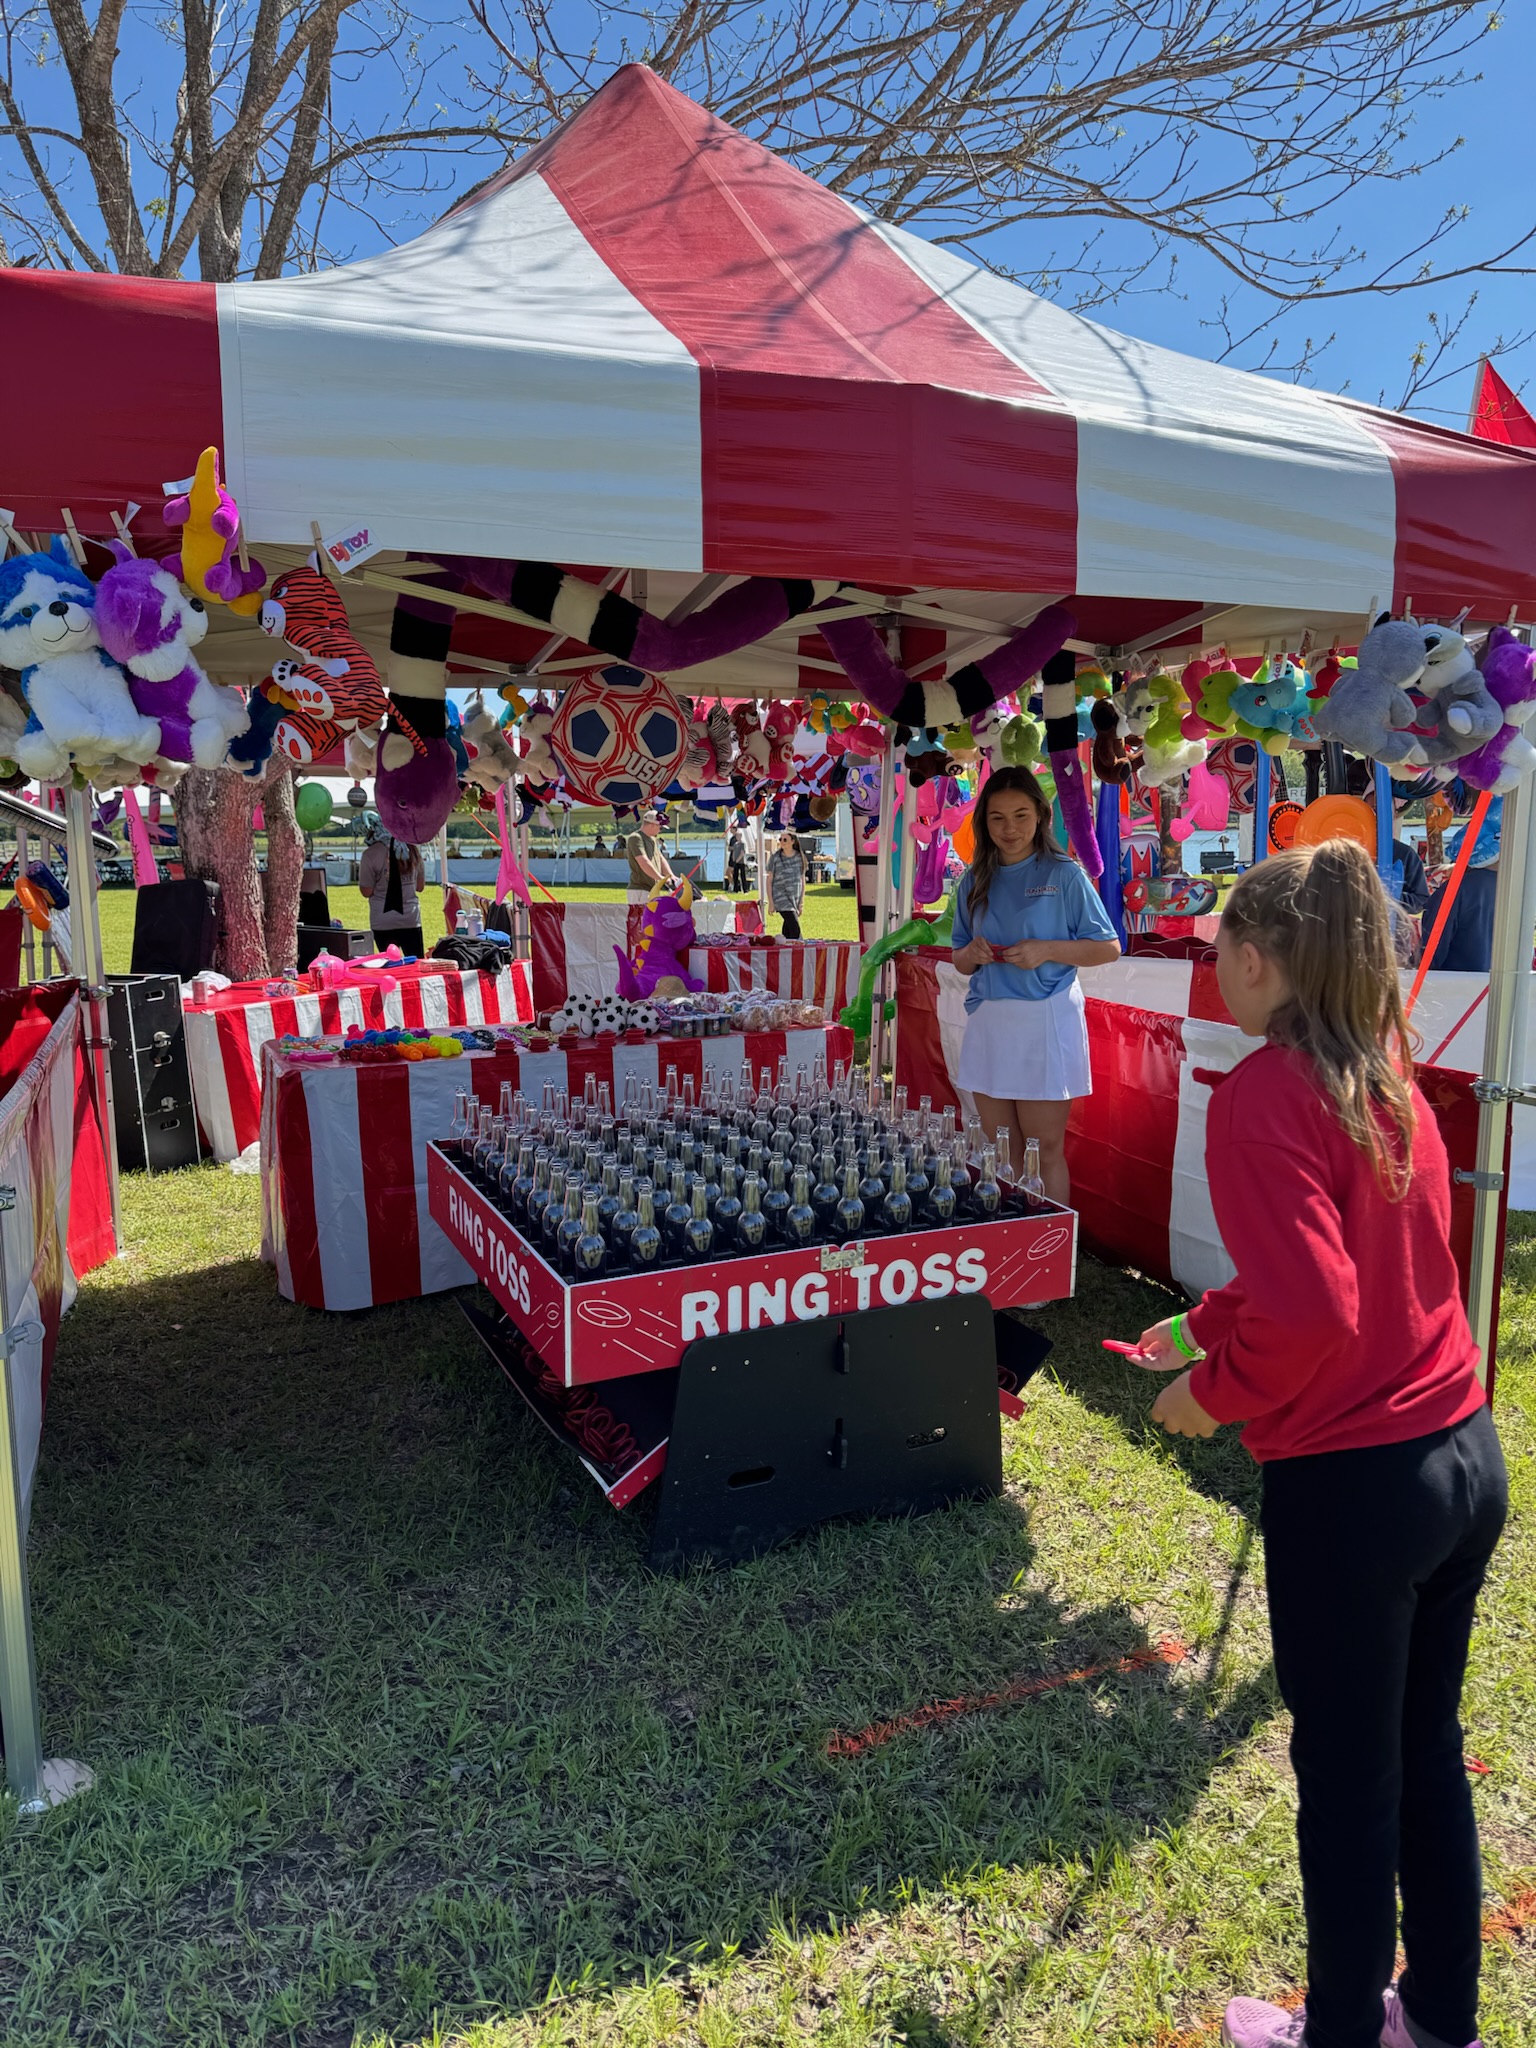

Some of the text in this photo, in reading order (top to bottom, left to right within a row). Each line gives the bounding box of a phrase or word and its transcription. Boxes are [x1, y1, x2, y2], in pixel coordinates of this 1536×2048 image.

[624, 750, 668, 787] USA
[449, 1184, 531, 1315] RING TOSS
[681, 1248, 988, 1341] RING TOSS
